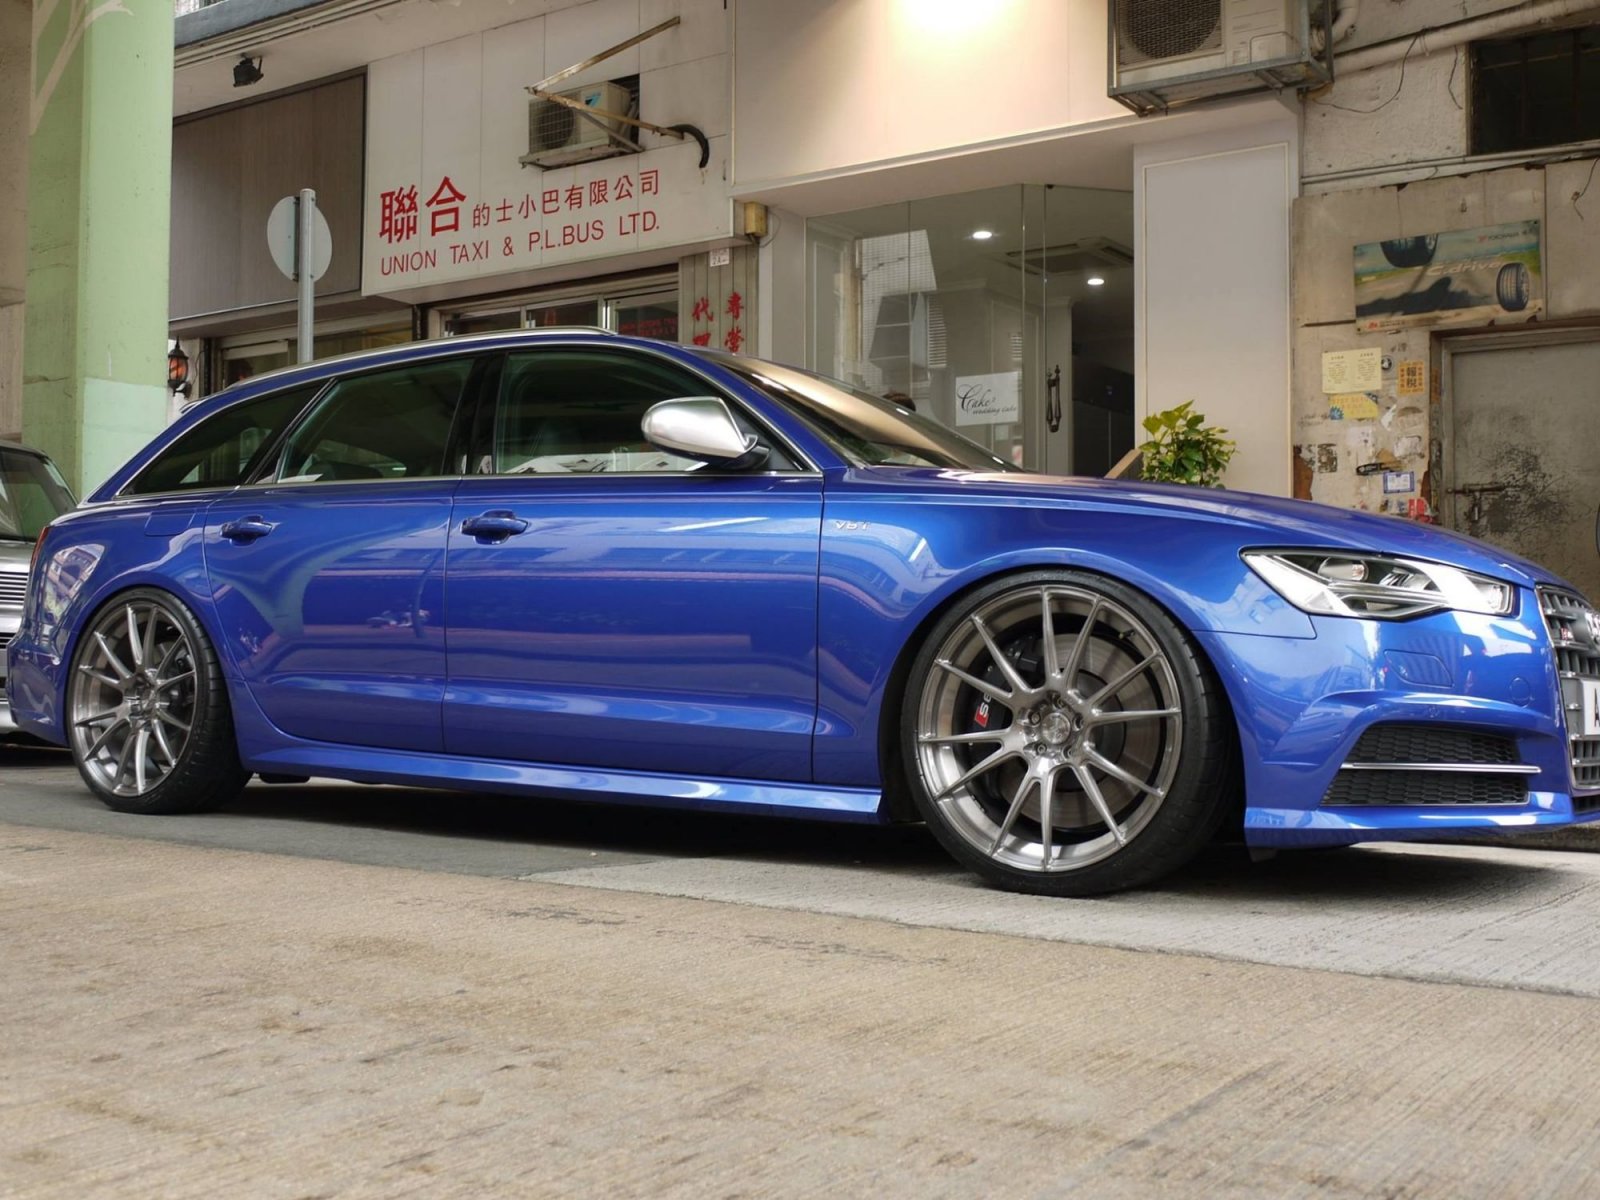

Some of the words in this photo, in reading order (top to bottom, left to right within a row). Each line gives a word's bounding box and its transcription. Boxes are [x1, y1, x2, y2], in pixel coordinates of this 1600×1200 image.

[379, 176, 467, 244] 聯合
[381, 249, 437, 276] UNION
[449, 240, 489, 264] TAXI
[503, 236, 514, 256] &
[619, 210, 660, 236] LTD.
